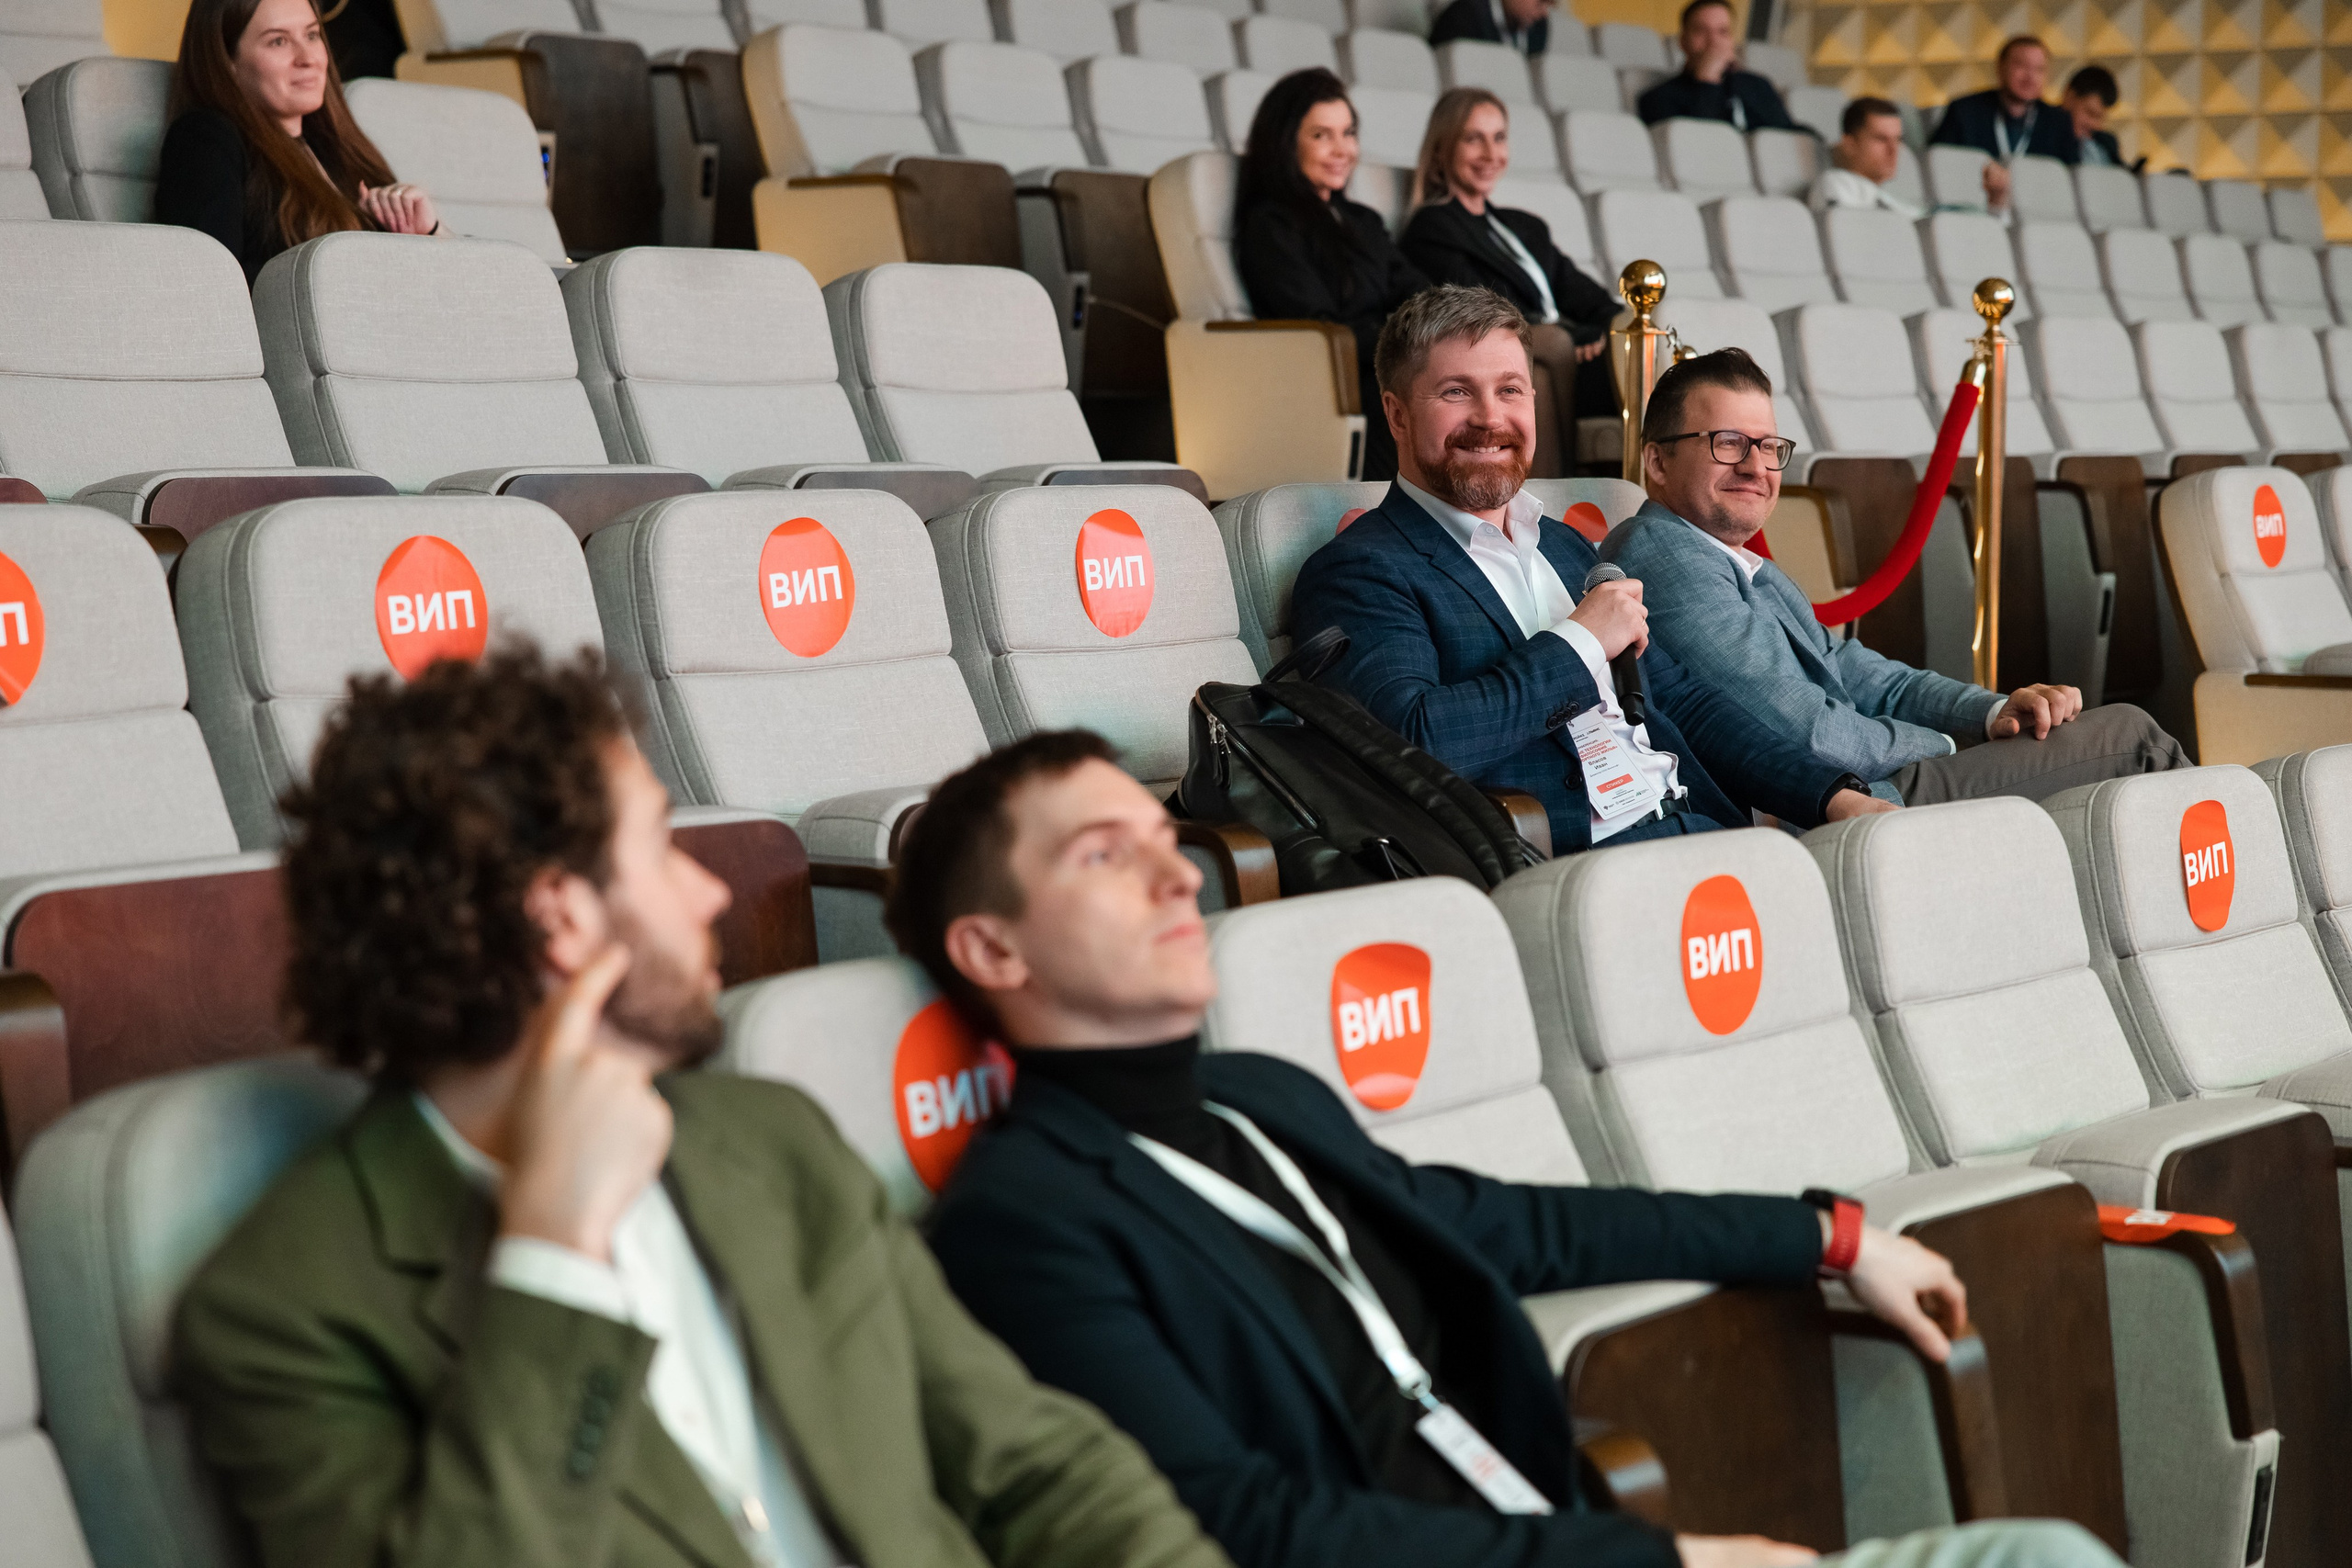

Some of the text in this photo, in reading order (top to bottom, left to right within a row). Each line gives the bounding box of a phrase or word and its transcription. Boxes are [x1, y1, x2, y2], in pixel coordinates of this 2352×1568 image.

[2256, 513, 2284, 538] ВИП
[768, 565, 843, 609] ВИП
[1083, 555, 1146, 592] ВИП
[387, 589, 476, 636] ВИП
[2184, 841, 2229, 887] ВИП
[1688, 928, 1755, 980] ВИП
[1339, 987, 1421, 1052] ВИП
[904, 1063, 1012, 1138] ВИП
